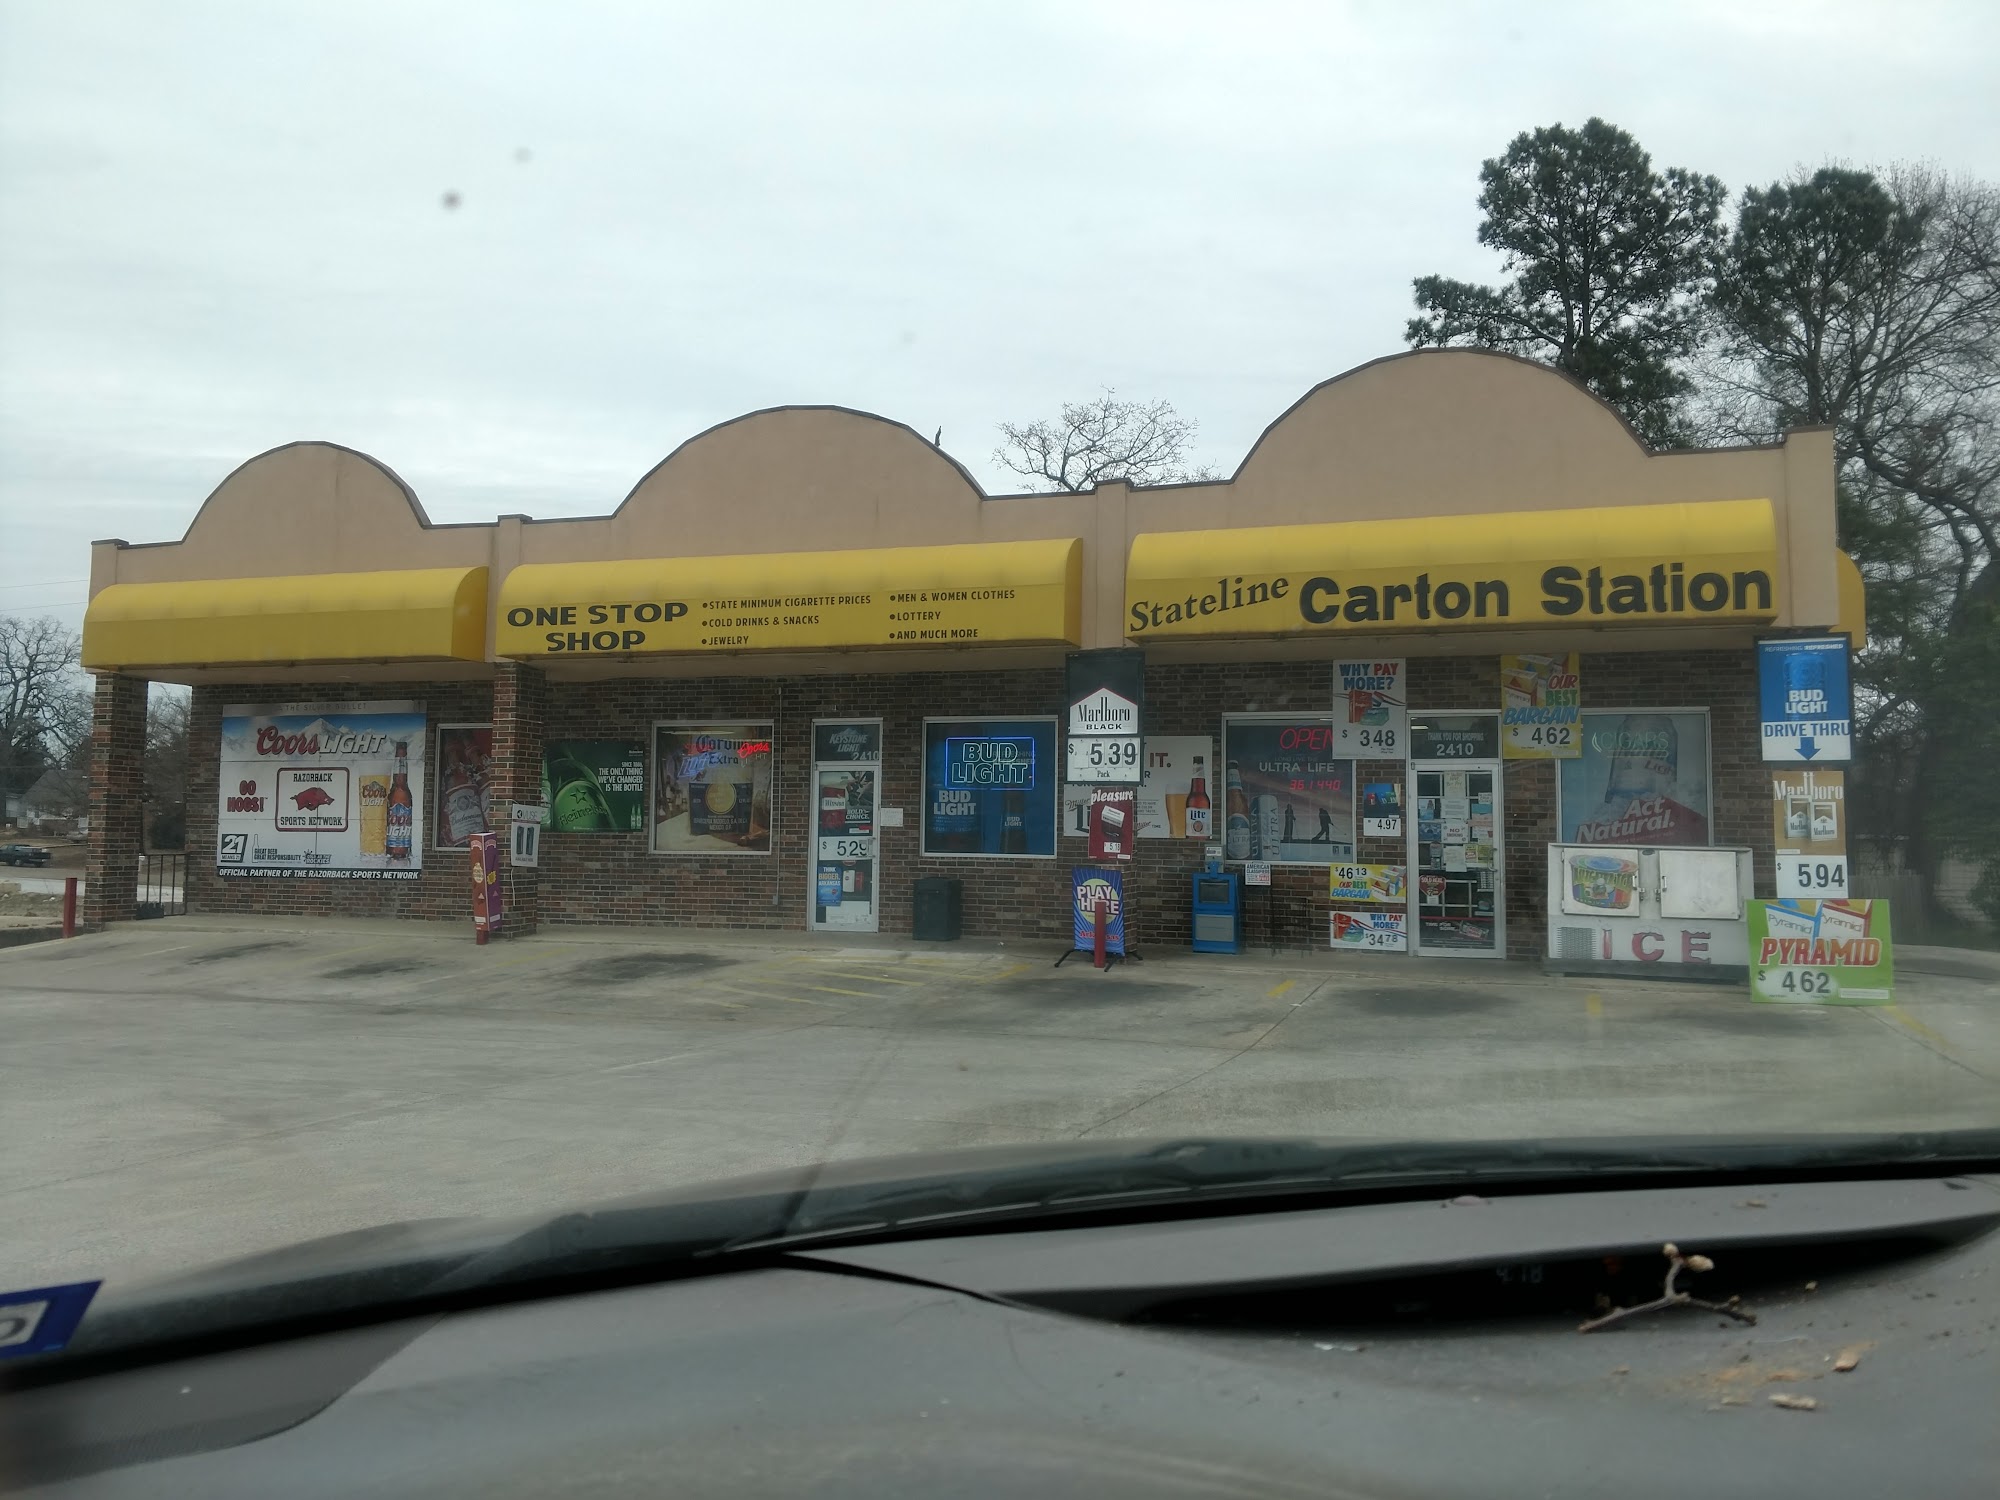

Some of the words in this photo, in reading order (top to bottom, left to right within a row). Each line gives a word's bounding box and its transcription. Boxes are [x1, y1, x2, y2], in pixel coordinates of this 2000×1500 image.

[897, 592, 918, 603] MEN
[920, 592, 928, 602] &
[931, 591, 968, 602] WOMEN
[971, 589, 1016, 600] CLOTHES
[1299, 572, 1509, 624] Carton
[1540, 561, 1772, 616] Station
[709, 600, 738, 611] STATE
[740, 598, 782, 610] MINIMUM
[785, 596, 836, 607] CIGARETTE
[838, 594, 871, 605] PRICES
[1129, 576, 1290, 632] Stateline
[507, 606, 577, 627] ONE
[587, 602, 689, 625] STOP
[709, 618, 733, 628] COLD
[735, 616, 770, 627] DRINKS
[773, 615, 780, 626] &
[783, 615, 820, 625] SNACKS
[897, 611, 941, 622] LOTTERY
[545, 630, 646, 652] SHOP
[708, 635, 749, 646] JEWELRY
[897, 629, 918, 640] AND
[920, 628, 948, 640] MUCH
[950, 628, 979, 639] MORE
[1339, 664, 1372, 676] WHY
[1374, 663, 1399, 676] PAY
[1343, 677, 1395, 691] MORE?
[1549, 674, 1578, 689] OUR
[1546, 690, 1578, 706] BEST
[1788, 689, 1824, 702] BUD
[1078, 696, 1131, 723] Marlboro
[1785, 700, 1828, 714] LIGHT
[1502, 706, 1580, 726] BARGAIN
[1764, 723, 1807, 738] DRIVE
[1811, 721, 1850, 737] THRU
[257, 725, 320, 756] Coors
[319, 734, 387, 754] LIGHT
[829, 732, 868, 744] KEYSTONE
[1341, 729, 1348, 738] $
[1360, 729, 1396, 749] 3.48
[1512, 727, 1519, 737] $
[1531, 727, 1571, 747] 4.62
[1601, 731, 1669, 749] CIGARS
[837, 743, 860, 753] LIGHT
[962, 742, 1018, 763] BUD
[1068, 743, 1075, 755] $
[1090, 742, 1136, 766] 5.39
[1436, 743, 1474, 757] 2410
[852, 750, 879, 761] 2410
[598, 768, 609, 776] THE
[609, 768, 625, 776] ONLY
[626, 768, 644, 776] THING
[952, 762, 1028, 784] LIGHT
[1097, 770, 1110, 778] Pack
[1259, 762, 1301, 773] ULTRA
[1307, 762, 1335, 773] LIFE
[292, 773, 333, 782] RAZORBACK
[598, 776, 616, 784] WE'VE
[616, 776, 644, 784] CHANGED
[605, 784, 611, 792] IS
[612, 784, 623, 792] THE
[624, 784, 644, 792] BOTTLE
[1773, 772, 1844, 800] Marlboro
[362, 798, 385, 806] LIGHT
[938, 790, 971, 803] BUD
[1090, 789, 1134, 805] pleasure
[933, 802, 977, 816] LIGHT
[1624, 795, 1666, 819] Act
[280, 817, 306, 826] SPORTS
[308, 817, 343, 826] NETWORK
[1190, 809, 1206, 821] Lite
[1377, 819, 1397, 831] 4.97
[1577, 809, 1676, 844] Natural.
[223, 835, 246, 854] 21
[822, 841, 828, 851] $
[219, 868, 248, 877] OFFICIAL
[250, 869, 279, 878] PARTNER
[280, 869, 291, 878] OF
[293, 870, 306, 878] THE
[308, 870, 351, 879] RAZORBACK
[352, 870, 381, 879] SPORTS
[382, 871, 419, 880] NETWORK
[1777, 863, 1782, 871] $
[1798, 863, 1845, 889] 5.94
[1353, 880, 1367, 890] BEST
[1076, 885, 1112, 900] PLAY
[1331, 889, 1372, 899] BARGAIN
[1370, 913, 1387, 922] WHY
[1388, 914, 1403, 922] PAY
[1769, 914, 1812, 935] Pyramid
[1373, 921, 1400, 929] MORE?
[1601, 924, 1712, 965] ICE
[1758, 937, 1883, 967] PYRAMID
[1757, 970, 1766, 981] $
[1782, 971, 1830, 996] 4.62
